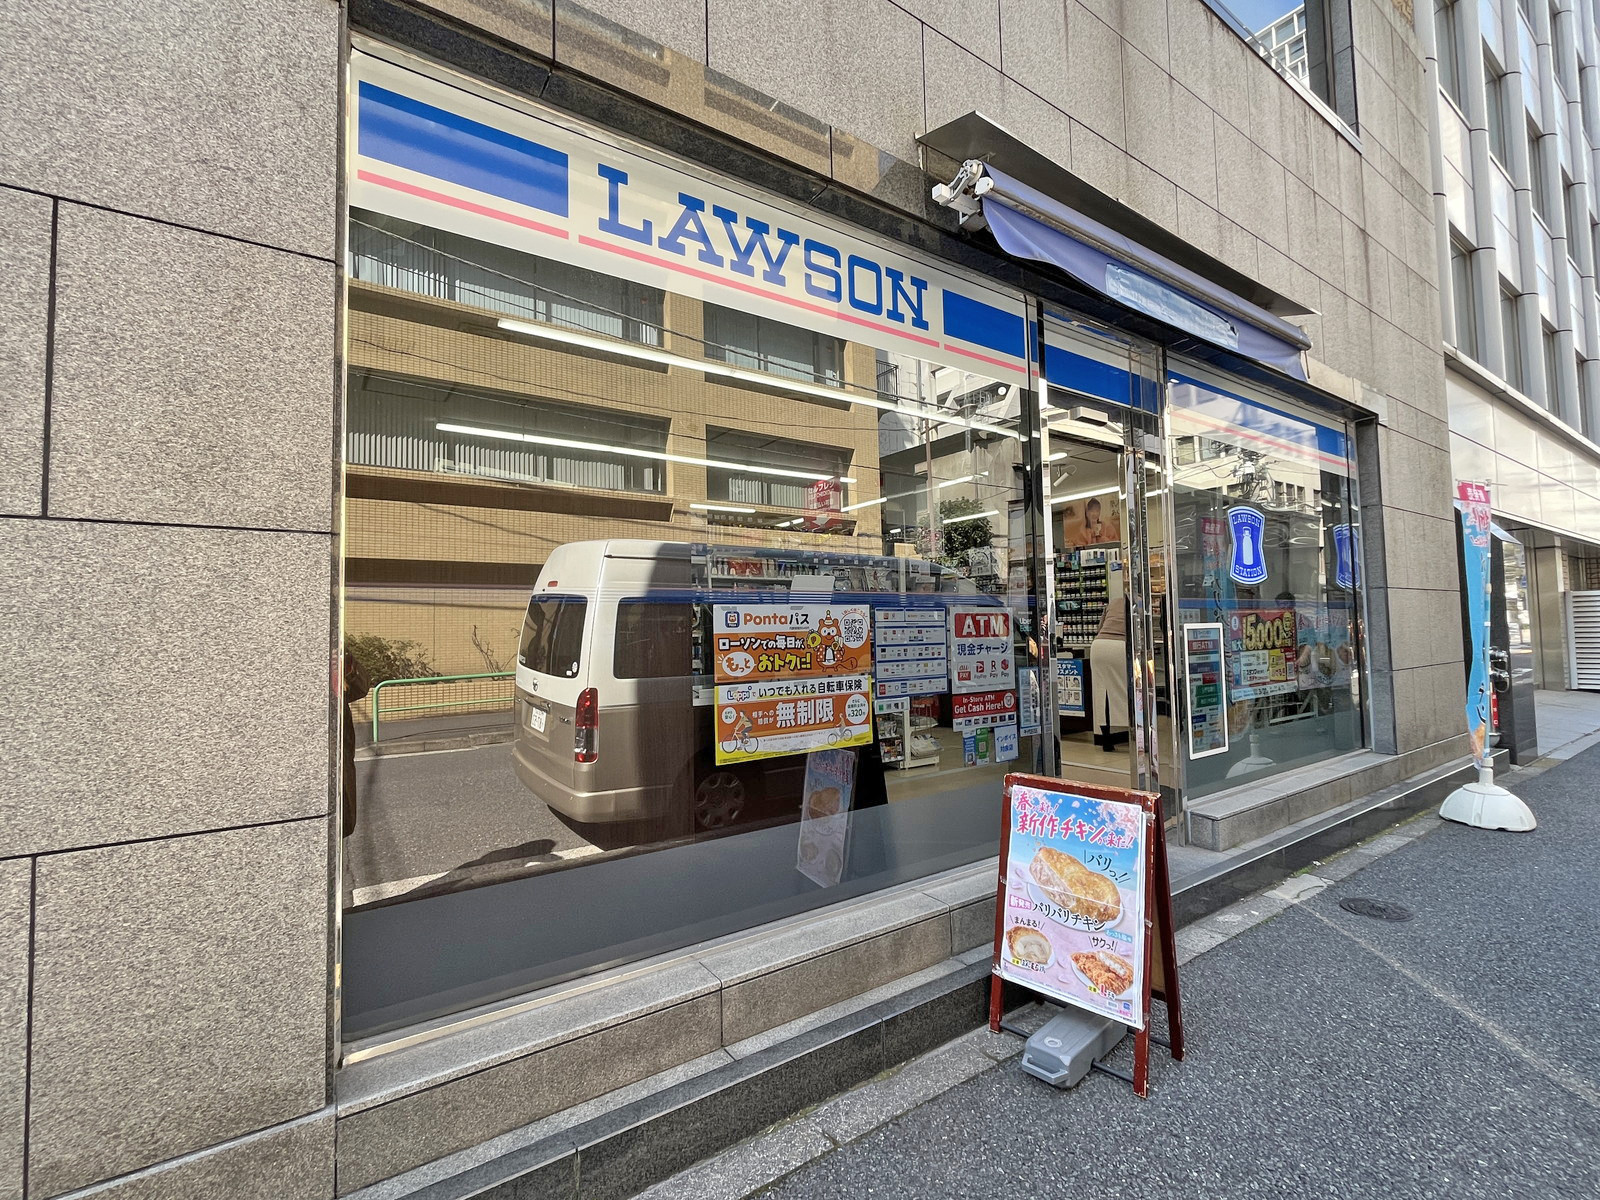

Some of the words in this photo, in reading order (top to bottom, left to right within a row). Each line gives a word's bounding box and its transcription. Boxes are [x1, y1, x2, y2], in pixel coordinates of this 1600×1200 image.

[598, 162, 929, 331] LAWSON
[1232, 513, 1260, 527] LAWSON
[1234, 564, 1263, 577] STATION
[743, 612, 810, 626] Pontaパス
[962, 615, 1004, 636] ATM
[1019, 617, 1032, 625] Uber
[717, 634, 806, 651] ローソンでの毎日が、
[957, 641, 1009, 656] 現金チャージ
[725, 656, 751, 673] もっと
[758, 651, 811, 672] おトクに!
[962, 695, 983, 703] In-Store
[776, 697, 834, 728] 無制限
[954, 705, 966, 714] Get
[967, 703, 984, 713] Cash
[985, 700, 1004, 711] Here!
[996, 733, 1016, 743] インボイス
[1016, 811, 1135, 848] 新作チキンが来た!
[1013, 915, 1041, 929] まんまる!
[1032, 901, 1106, 931] パリパリチキン
